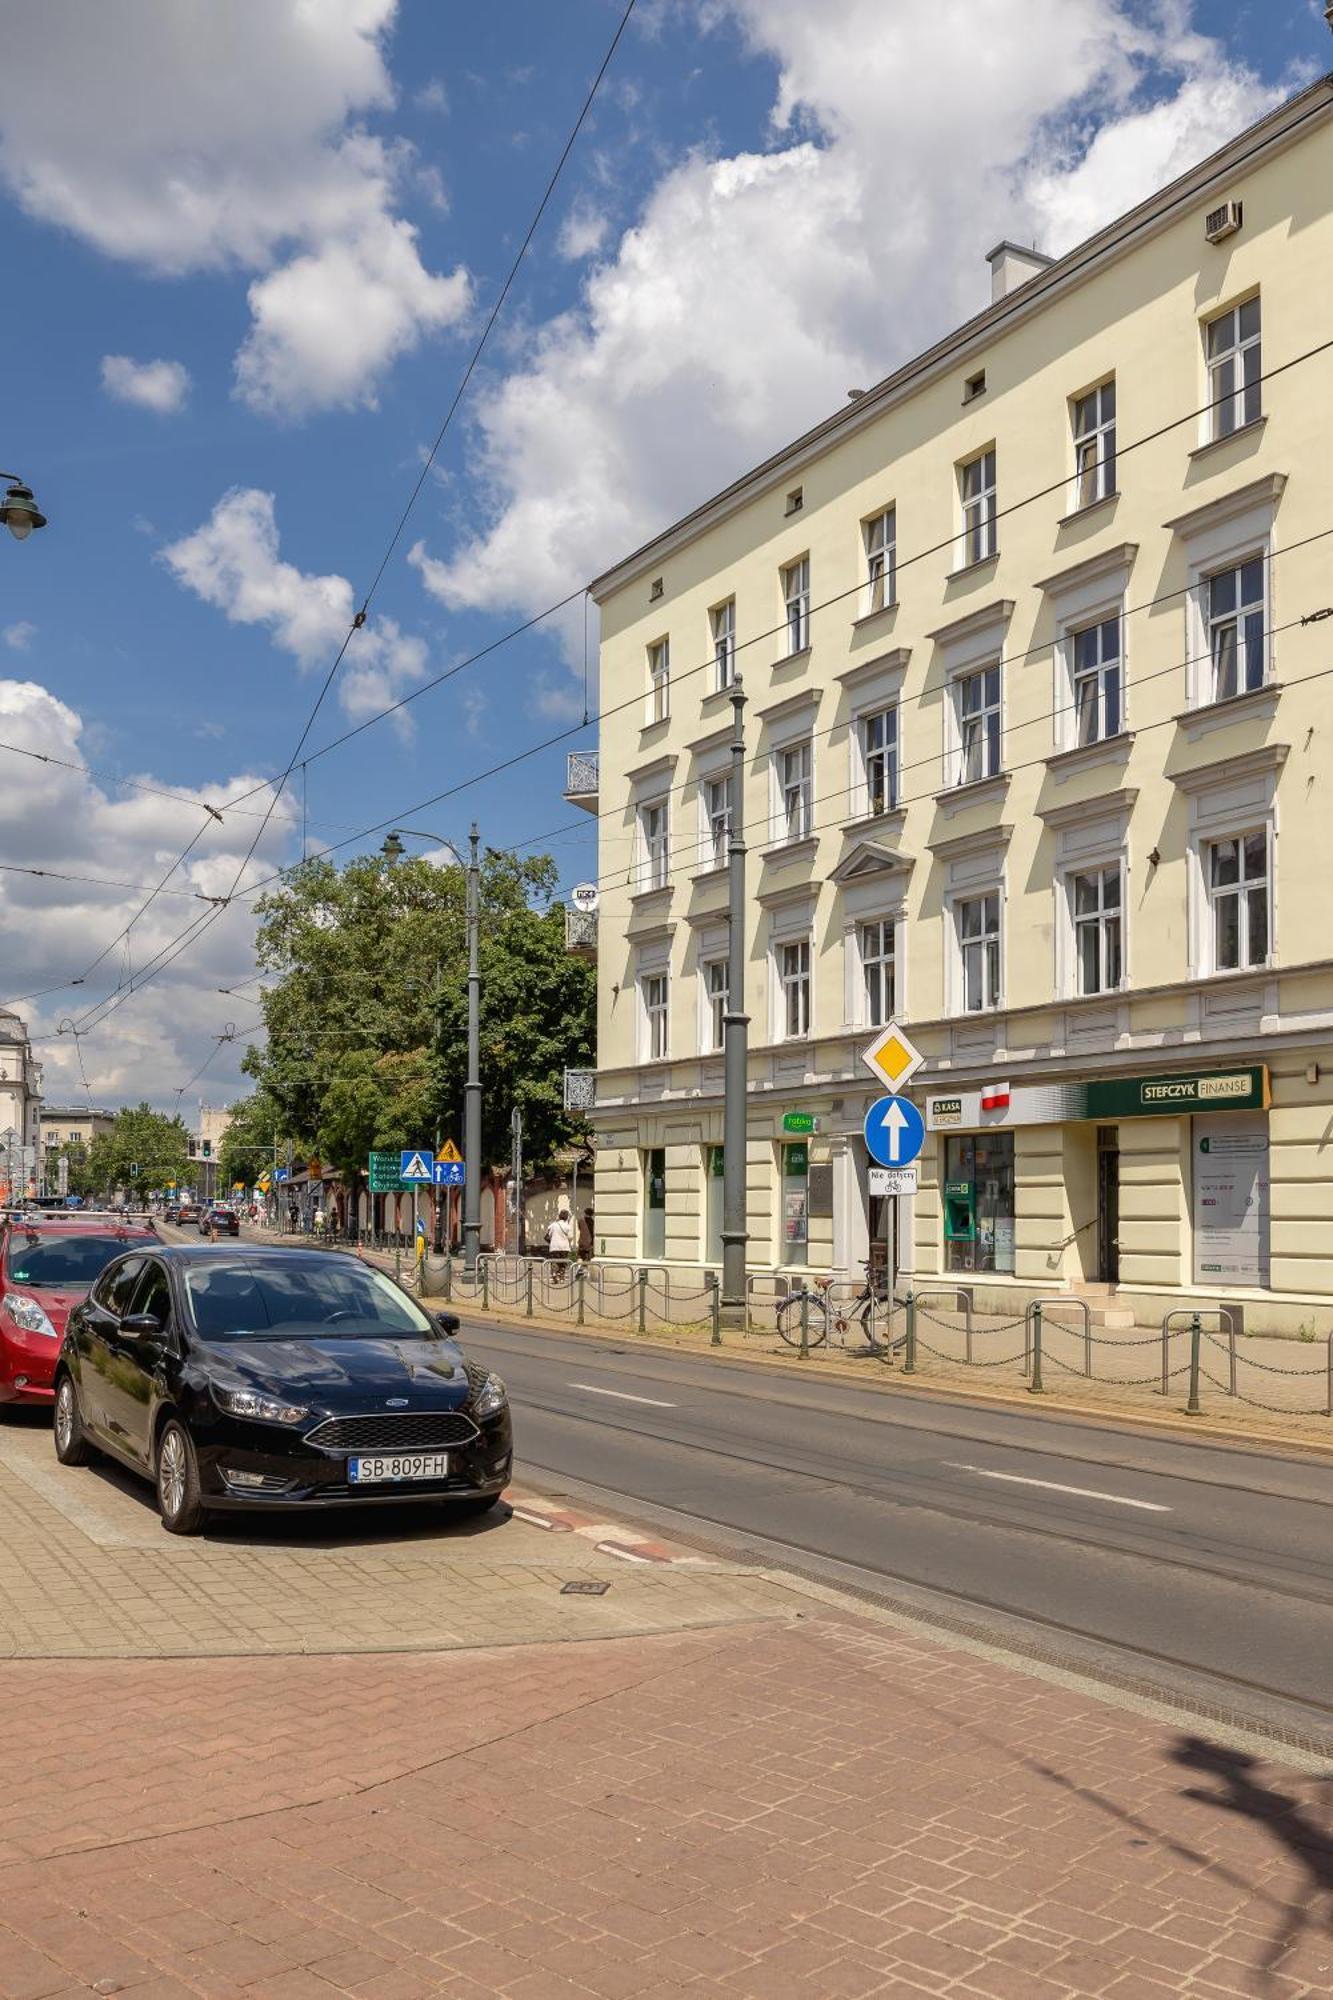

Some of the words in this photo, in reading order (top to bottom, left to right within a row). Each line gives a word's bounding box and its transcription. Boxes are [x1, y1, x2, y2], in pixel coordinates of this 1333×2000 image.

[1145, 1083, 1195, 1099] STEFCZYK
[1200, 1079, 1247, 1096] FINANSE
[941, 1101, 961, 1111] KASA
[871, 1170, 884, 1179] Nie
[887, 1169, 914, 1181] dotyczy
[362, 1459, 384, 1478] SB
[391, 1457, 445, 1476] 809FH
